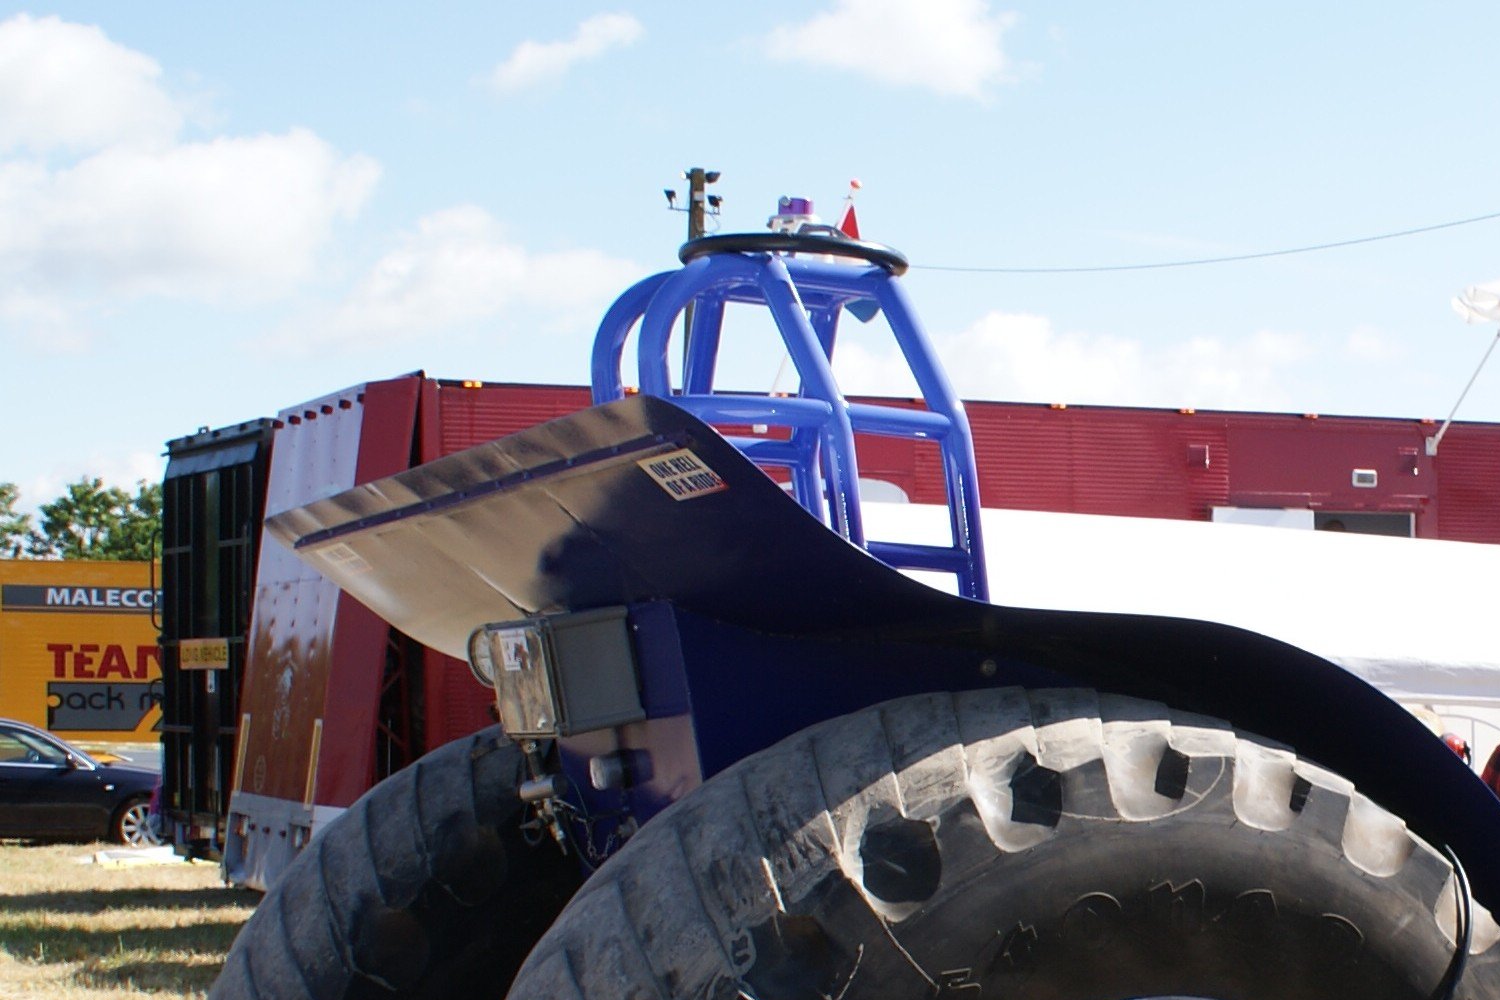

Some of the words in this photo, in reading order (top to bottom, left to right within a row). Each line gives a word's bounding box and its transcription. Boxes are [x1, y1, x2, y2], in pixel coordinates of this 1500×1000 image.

[648, 461, 678, 479] ONE
[667, 455, 702, 474] HELL
[665, 480, 687, 496] OF
